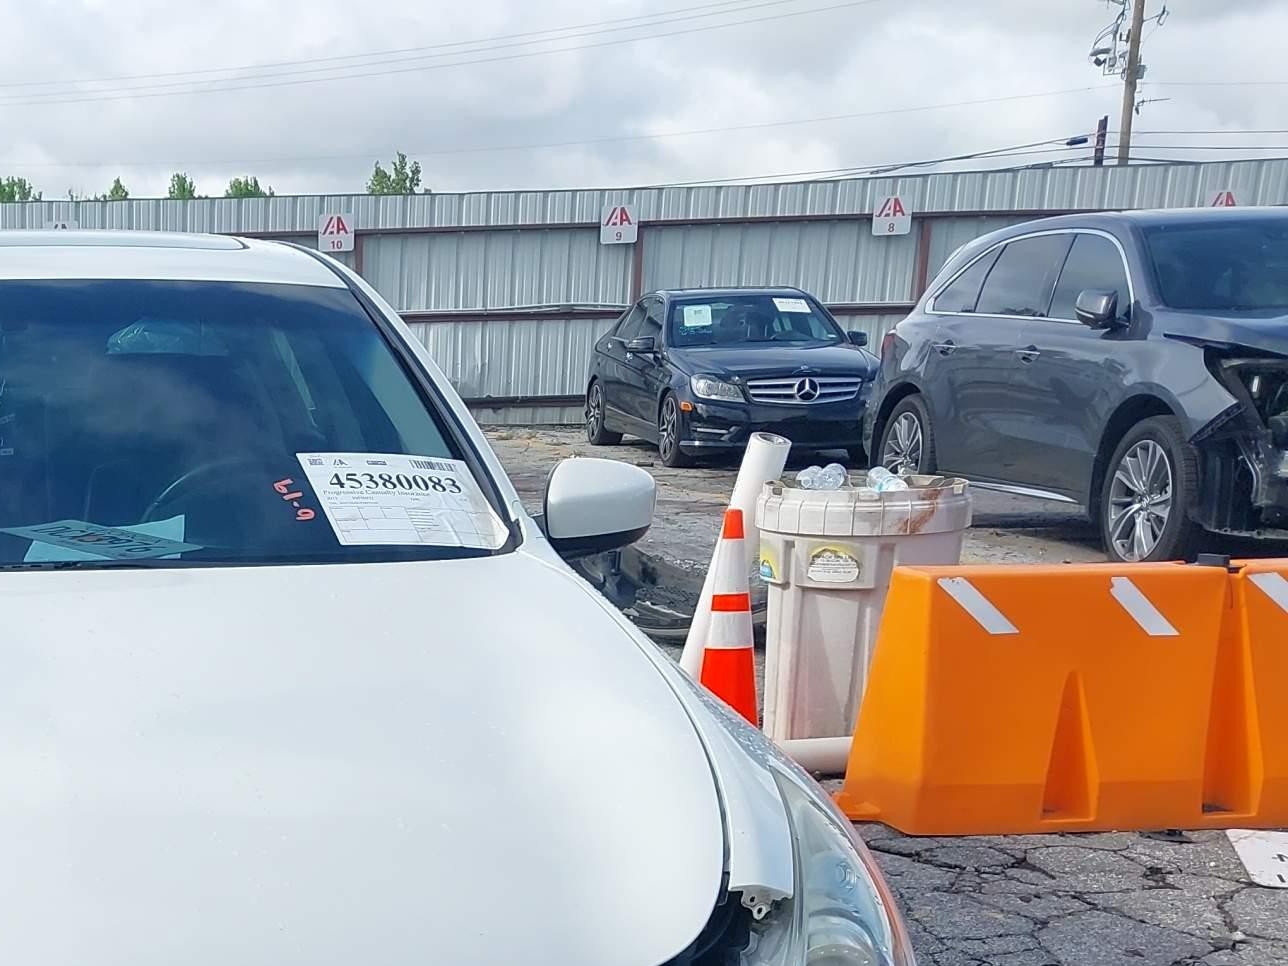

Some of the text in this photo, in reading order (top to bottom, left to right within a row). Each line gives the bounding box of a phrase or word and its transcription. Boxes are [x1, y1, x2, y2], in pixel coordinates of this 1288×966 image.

[887, 222, 896, 233] 8
[615, 231, 623, 242] 9
[330, 239, 343, 250] 10
[329, 472, 462, 494] 45380083
